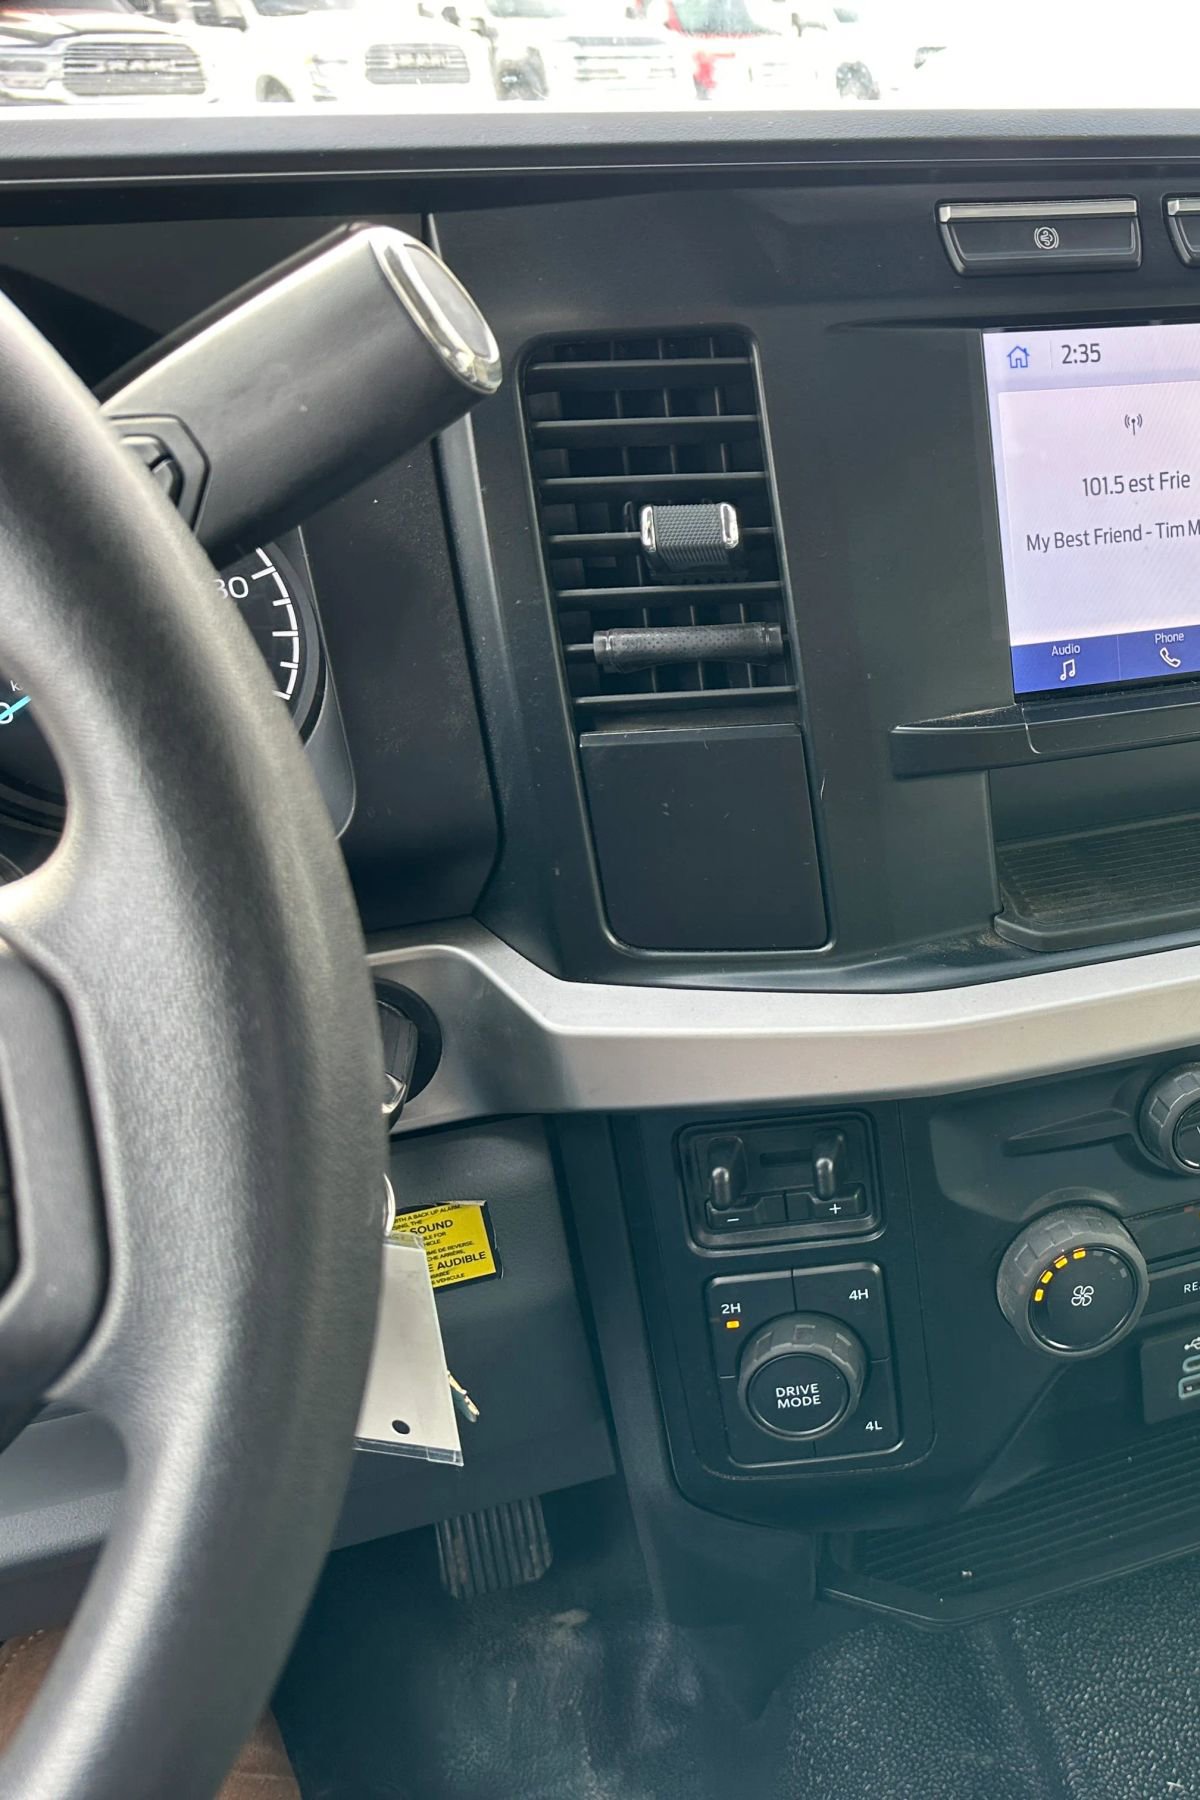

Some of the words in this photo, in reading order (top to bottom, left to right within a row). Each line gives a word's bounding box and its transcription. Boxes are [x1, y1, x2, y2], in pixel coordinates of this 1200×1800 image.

[1061, 343, 1101, 364] 2:35
[1082, 475, 1125, 497] 101.5
[1128, 473, 1155, 493] est
[1159, 470, 1191, 490] Frie
[1026, 534, 1050, 553] My
[1054, 530, 1090, 549] Best
[1094, 524, 1142, 545] Friend
[1155, 522, 1185, 539] Tim
[1154, 631, 1186, 645] Phone
[1051, 643, 1081, 657] Audio
[413, 1211, 430, 1220] BACK
[410, 1219, 453, 1235] SOUND
[437, 1251, 487, 1270] AUDIBLE
[848, 1288, 869, 1301] 4H
[720, 1303, 741, 1315] 2H
[775, 1383, 820, 1398] DRIVE
[776, 1394, 822, 1409] MODE
[865, 1420, 883, 1431] 4L
